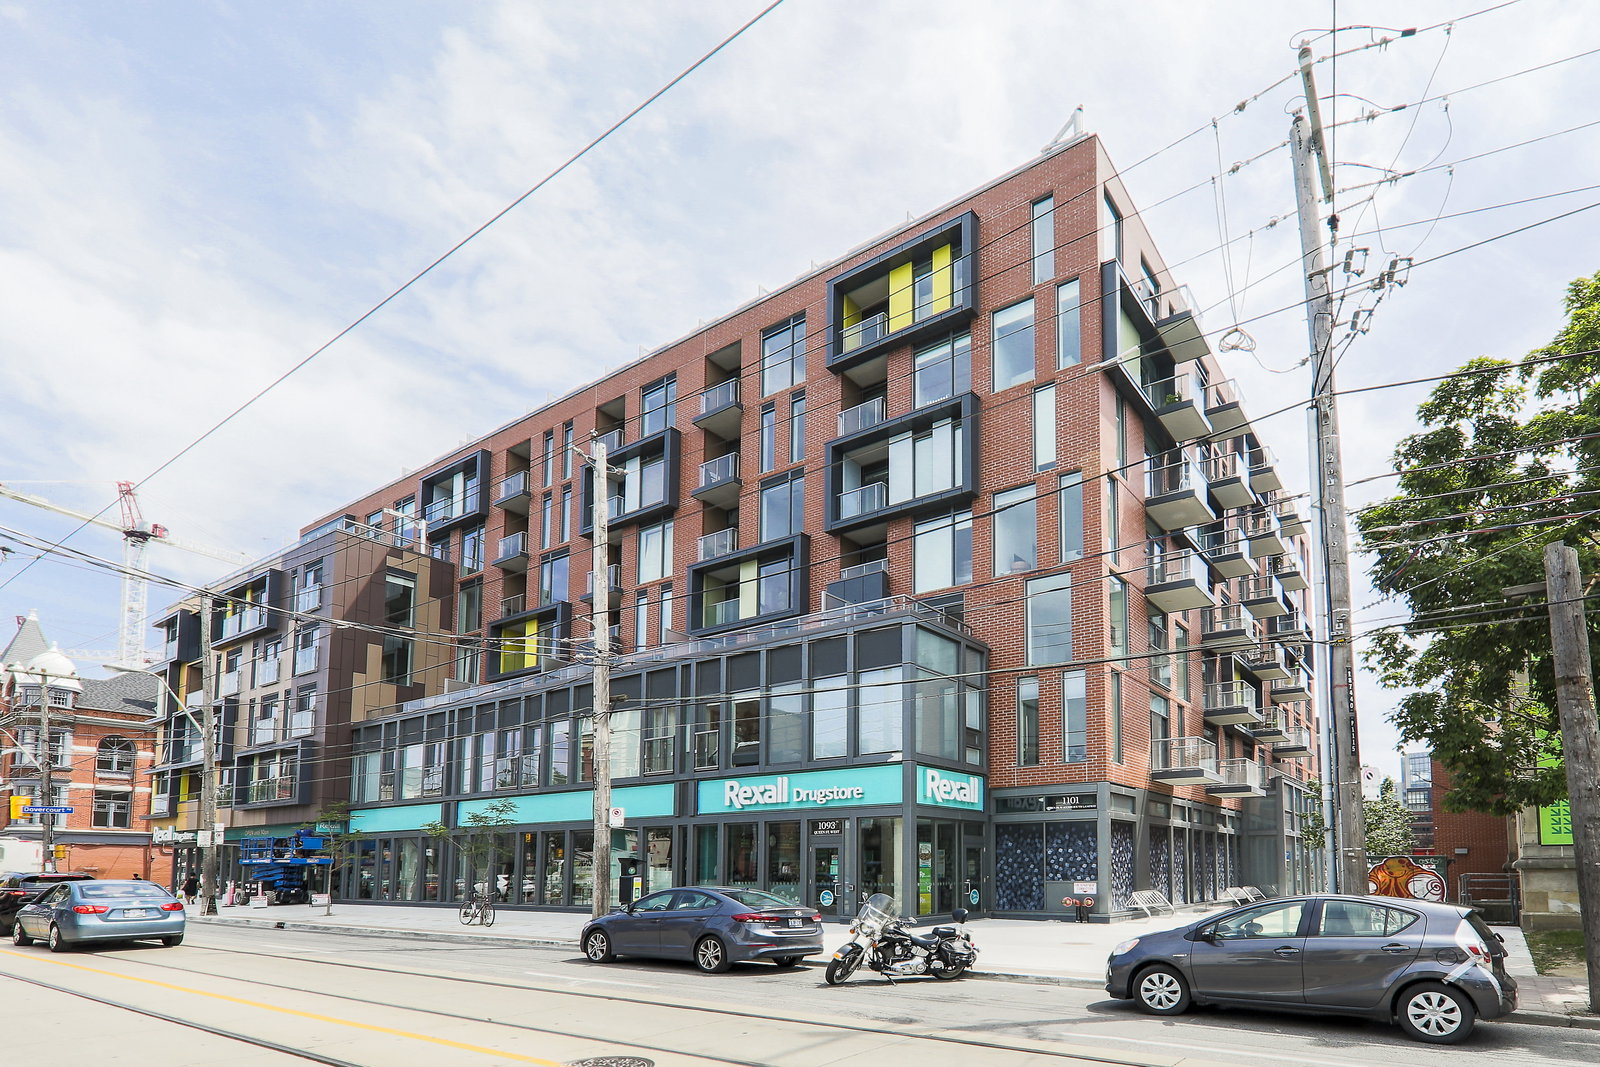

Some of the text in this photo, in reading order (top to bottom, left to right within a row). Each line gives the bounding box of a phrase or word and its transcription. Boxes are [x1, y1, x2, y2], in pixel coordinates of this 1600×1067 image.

[724, 776, 864, 809] Rexall Drugstore
[926, 769, 979, 803] Rexall
[1062, 796, 1080, 805] 1101
[818, 821, 836, 830] 1093
